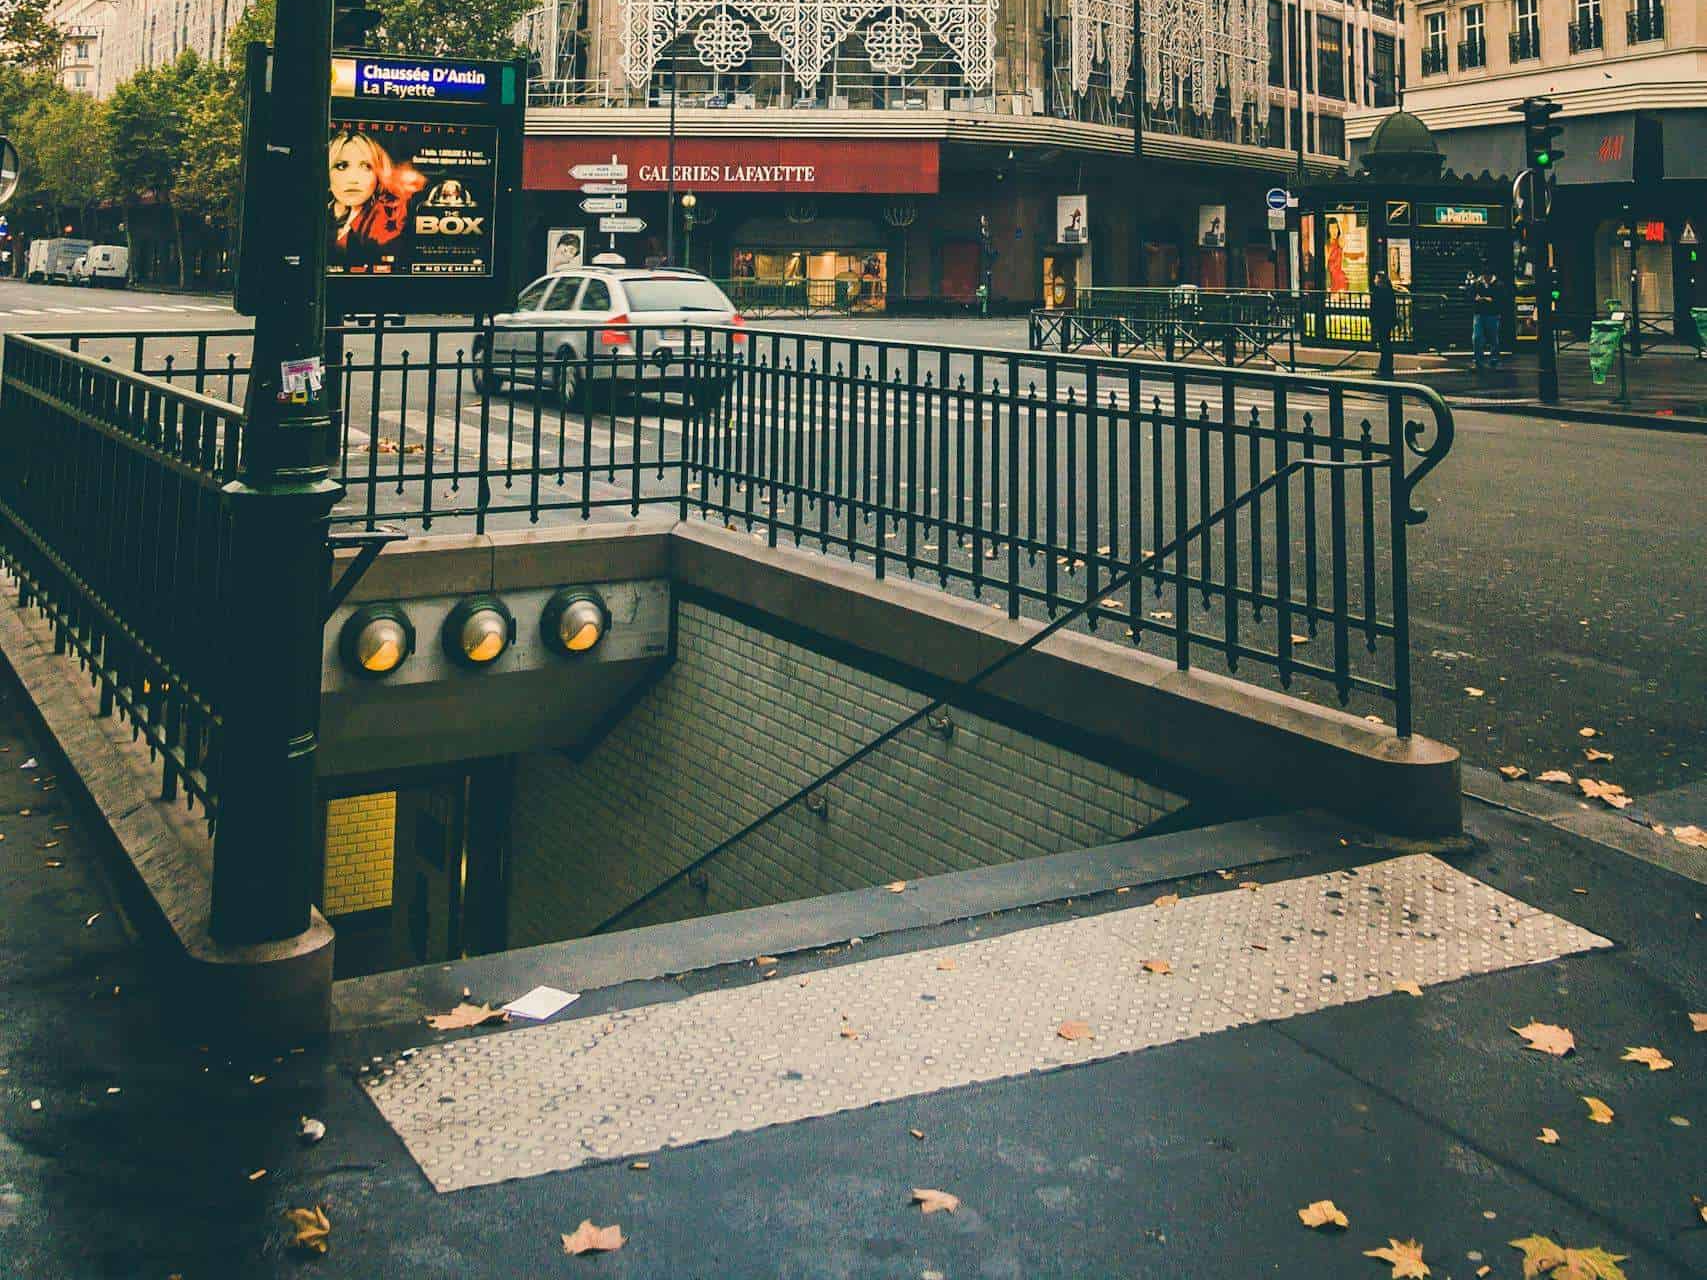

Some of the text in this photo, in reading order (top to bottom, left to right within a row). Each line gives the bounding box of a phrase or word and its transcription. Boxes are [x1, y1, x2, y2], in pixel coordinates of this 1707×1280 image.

[363, 64, 430, 82] Chaussée
[363, 80, 436, 99] La Fayette
[328, 122, 408, 133] AMERON
[638, 165, 816, 183] GALERIES LAFAYETTE
[415, 215, 485, 235] BOX
